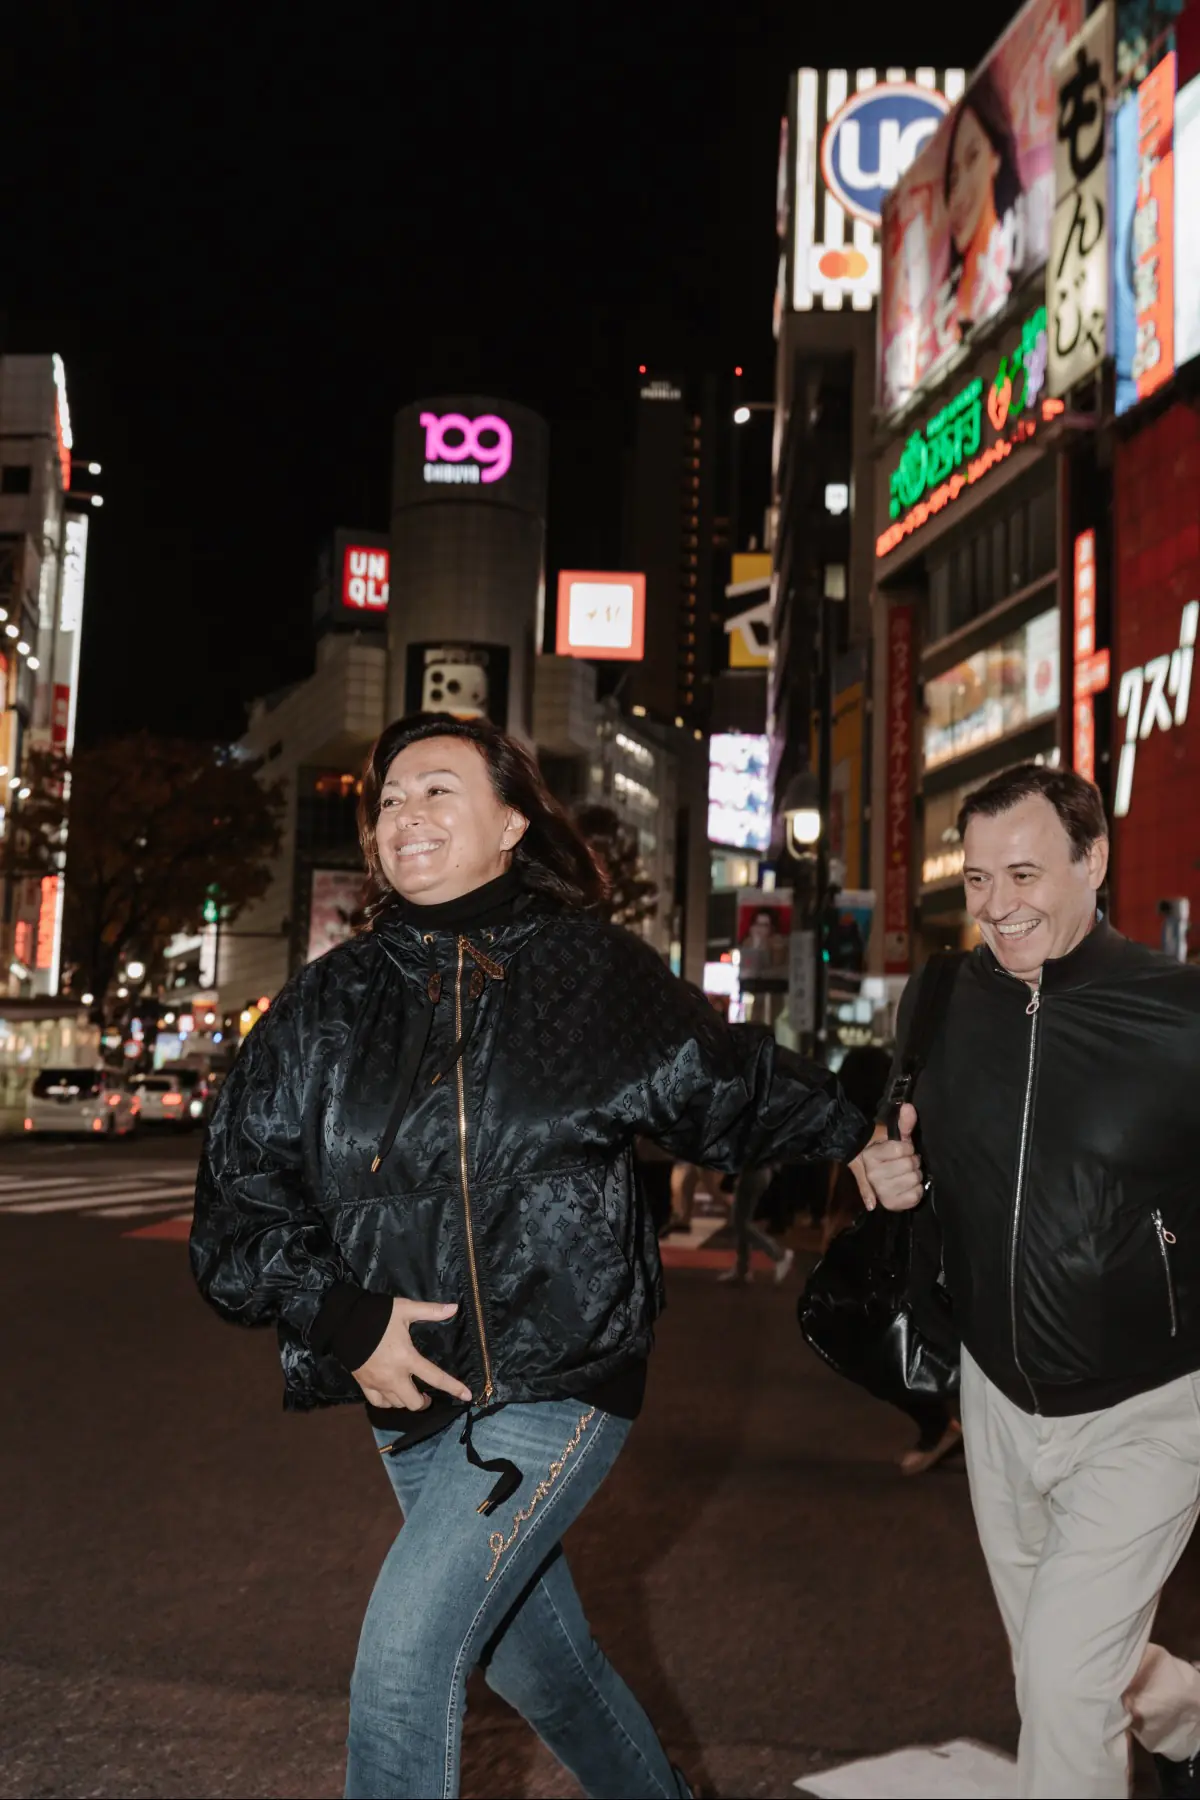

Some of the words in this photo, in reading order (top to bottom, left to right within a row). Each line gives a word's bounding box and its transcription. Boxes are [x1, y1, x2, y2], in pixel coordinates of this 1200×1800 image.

[420, 412, 513, 484] 109
[350, 551, 386, 580] UN
[1114, 599, 1200, 817] クスリ
